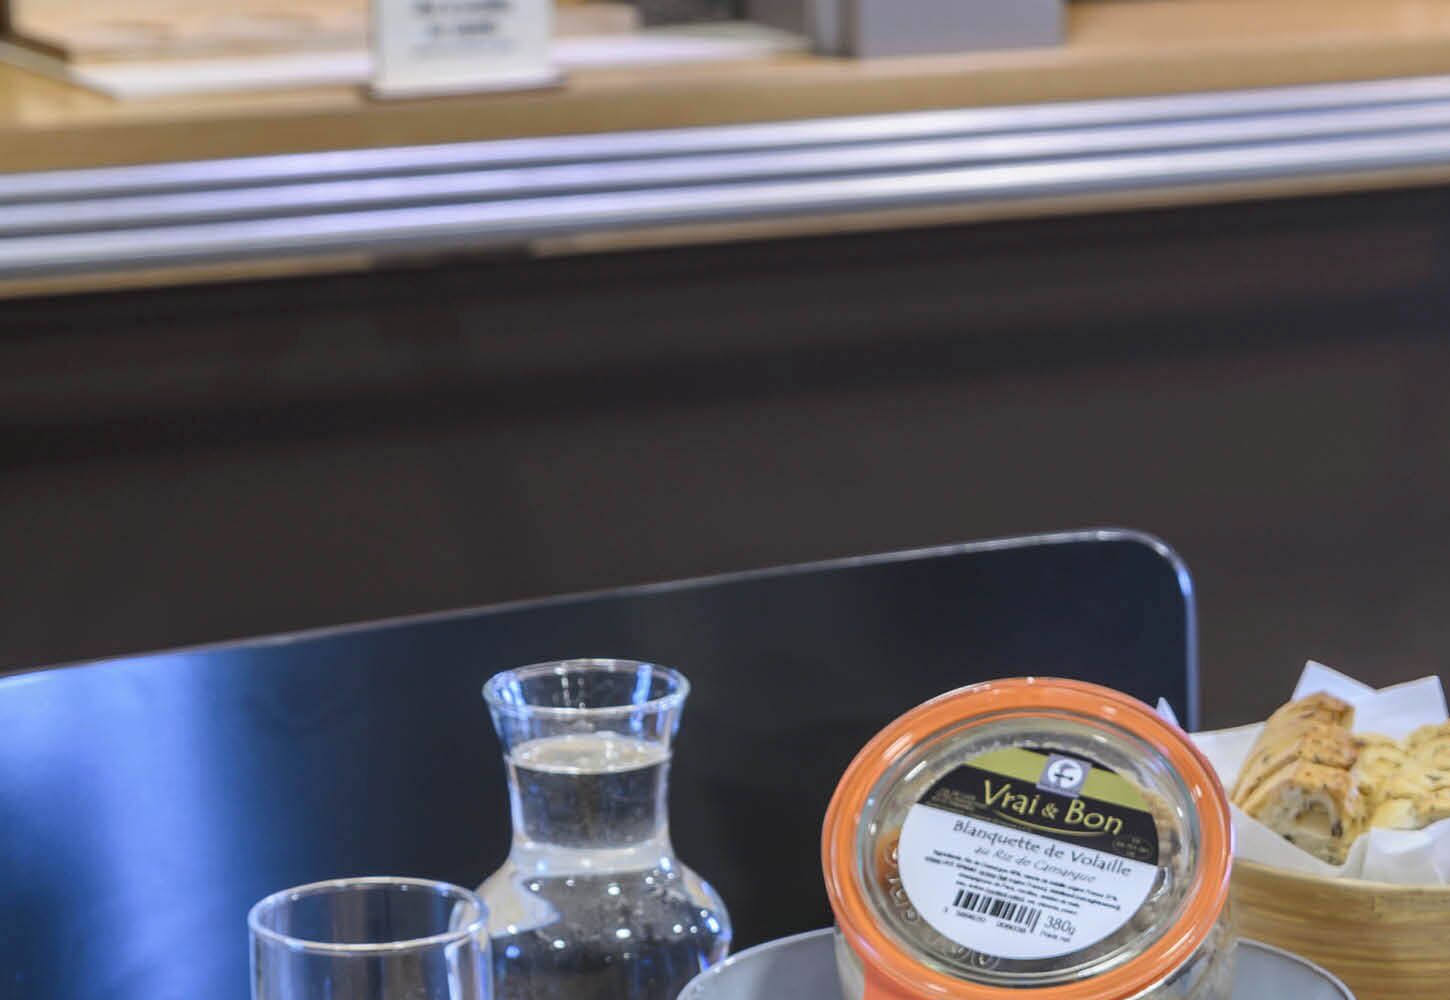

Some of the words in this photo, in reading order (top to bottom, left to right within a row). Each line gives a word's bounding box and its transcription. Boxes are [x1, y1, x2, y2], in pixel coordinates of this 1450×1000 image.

[983, 780, 1037, 814] Vrai
[1041, 803, 1060, 820] &
[1065, 797, 1124, 835] Bon
[953, 820, 1040, 856] Blanquette
[1044, 842, 1064, 859] de
[1071, 849, 1132, 877] Volaille
[1015, 854, 1034, 868] de
[1044, 914, 1077, 935] 380g
